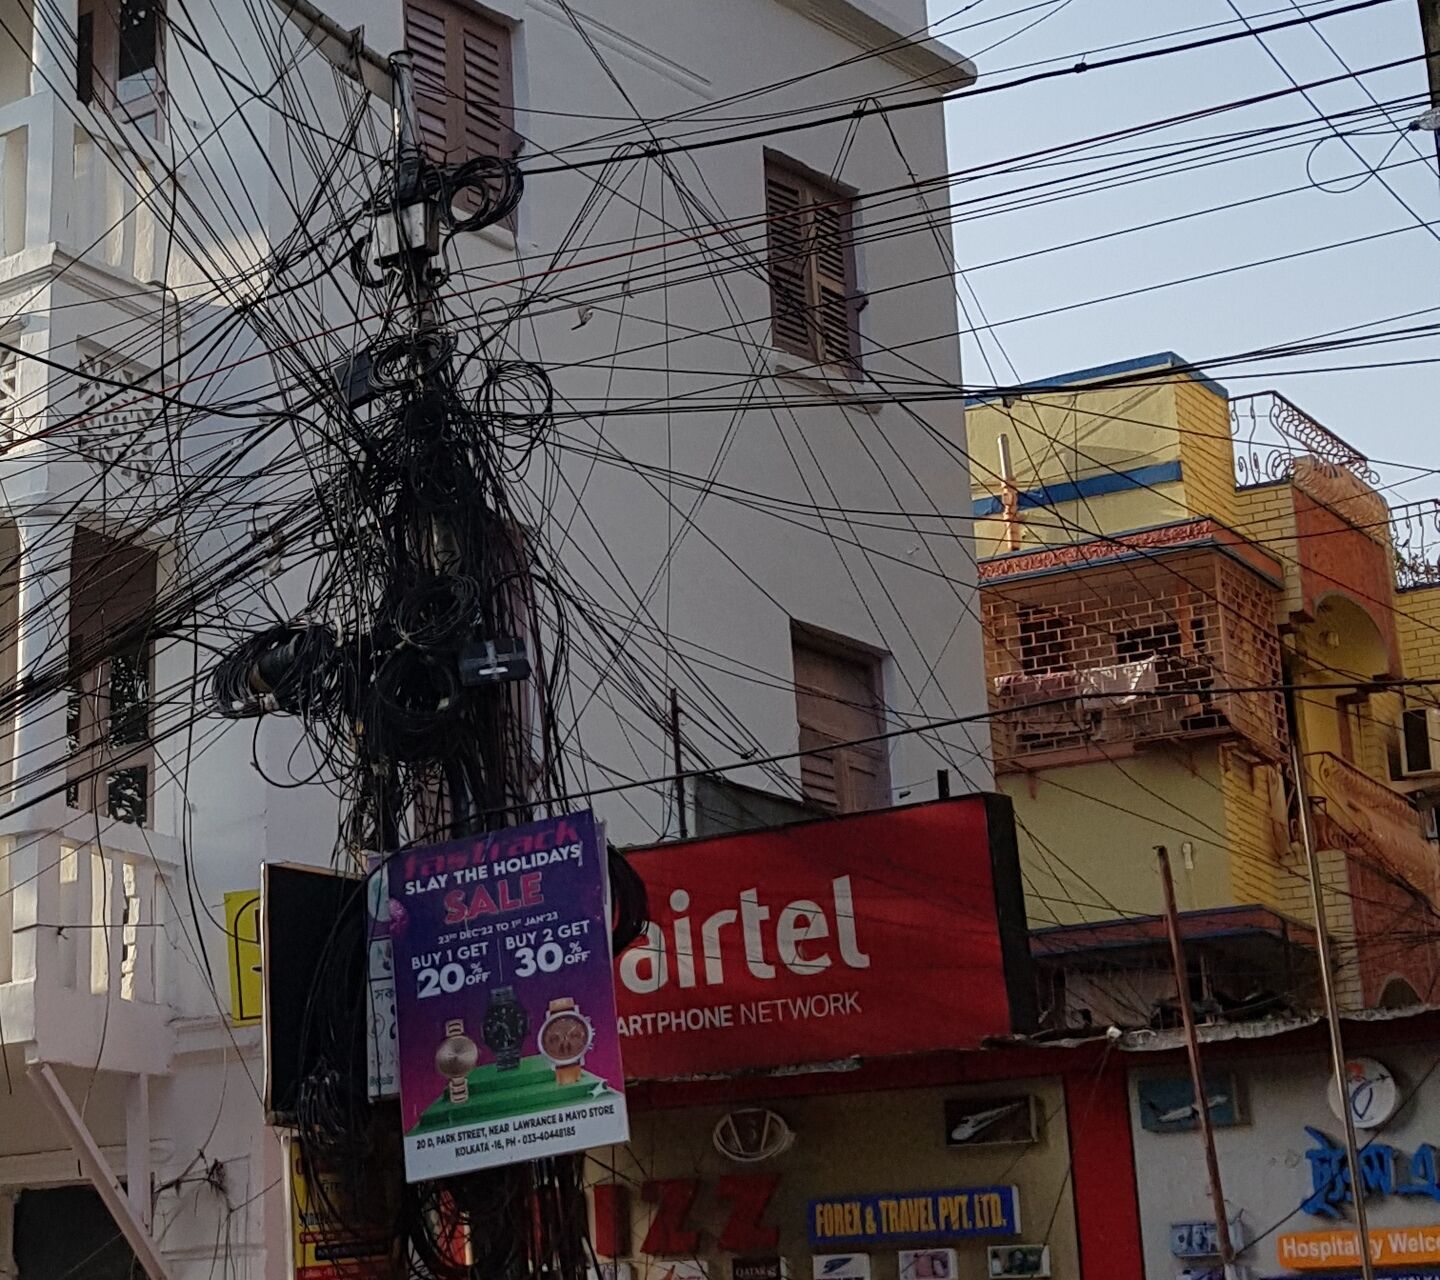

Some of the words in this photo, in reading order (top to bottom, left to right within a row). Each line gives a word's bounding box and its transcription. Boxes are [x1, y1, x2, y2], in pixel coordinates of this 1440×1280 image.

[405, 874, 449, 895] SLAY
[453, 865, 489, 885] THE
[493, 843, 581, 876] HOLIDAYS
[445, 871, 544, 925] SALE
[496, 922, 509, 933] TO
[505, 932, 537, 951] BUY
[543, 927, 554, 942] 2
[558, 919, 591, 938] GET
[619, 874, 870, 995] airtel
[411, 951, 442, 970] BUY
[457, 941, 489, 960] GET
[514, 942, 564, 978] 30
[564, 951, 592, 965] OFF
[417, 963, 465, 1000] 20
[465, 971, 492, 985] OFF
[740, 991, 862, 1025] NETWORK
[436, 1133, 456, 1147] PARK
[457, 1126, 488, 1143] STREET,
[489, 1123, 509, 1138] NEAR
[512, 1115, 557, 1133] LAWRANCE
[565, 1109, 587, 1123] MAYO
[588, 1104, 614, 1118] STORE
[455, 1143, 490, 1159] KOLKATA
[815, 1201, 862, 1237] FOREX
[865, 1206, 877, 1234] &
[879, 1197, 936, 1234] TRAVEL
[974, 1192, 1007, 1228] LTD.
